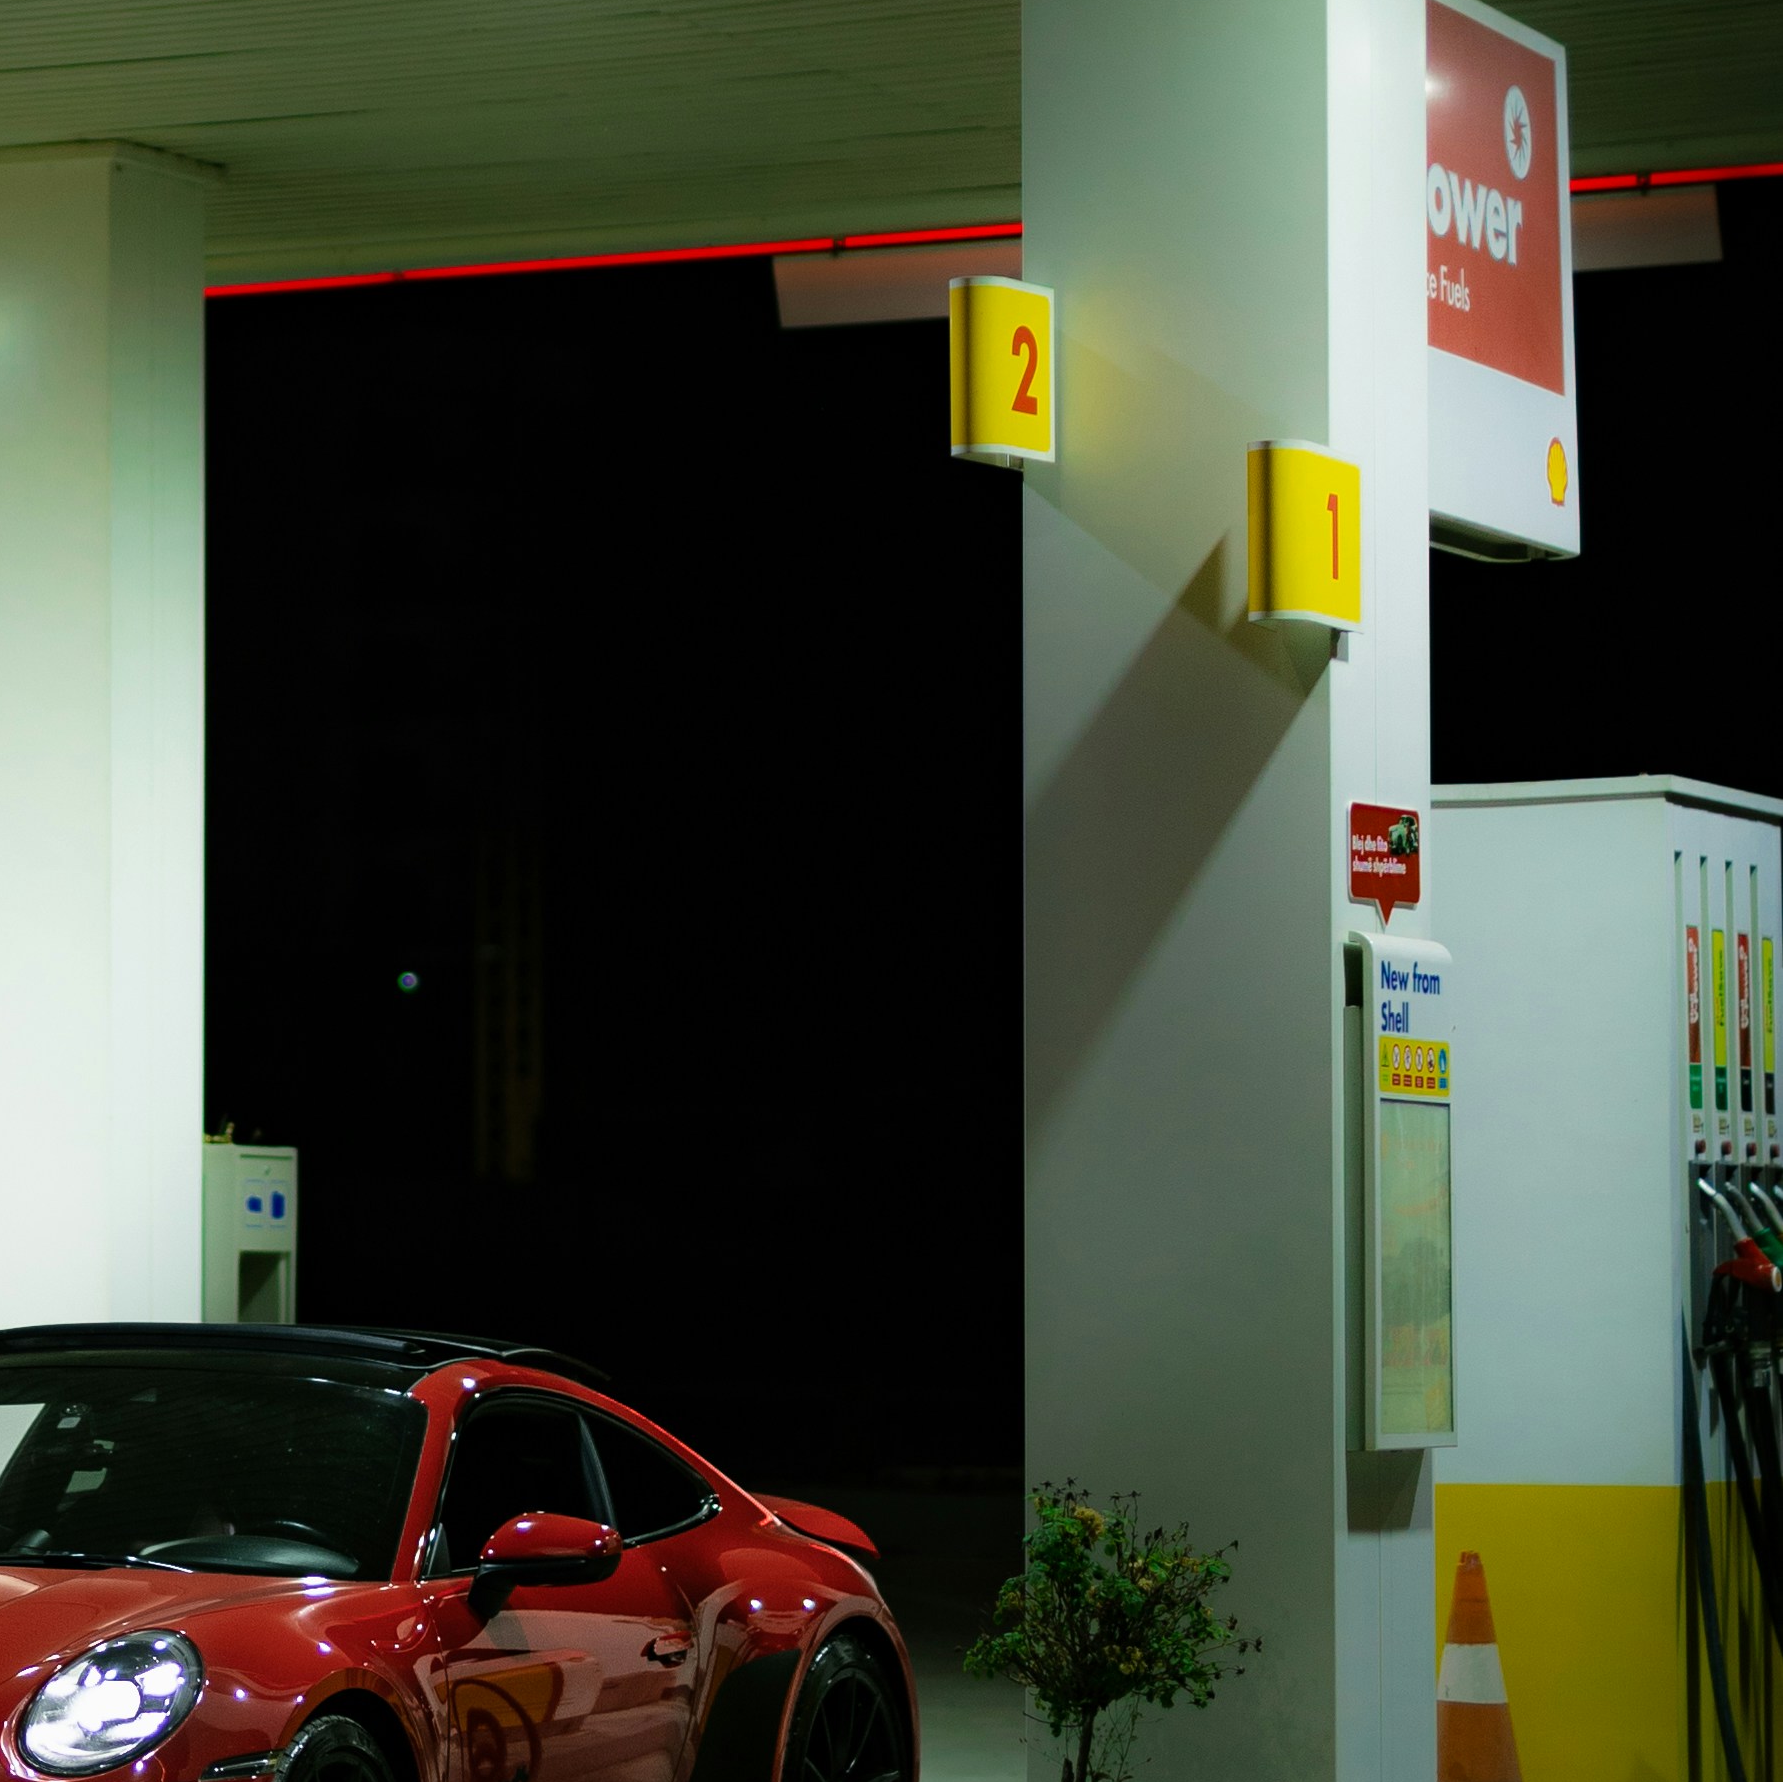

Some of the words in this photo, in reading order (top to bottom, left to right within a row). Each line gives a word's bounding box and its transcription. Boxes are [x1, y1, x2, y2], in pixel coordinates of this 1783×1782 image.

[1426, 161, 1524, 266] ower
[1440, 264, 1471, 313] Fuels
[1011, 325, 1038, 416] 2
[1327, 493, 1339, 581] 1
[1381, 960, 1409, 992] New
[1412, 961, 1441, 995] from
[1381, 1001, 1409, 1034] Shell
